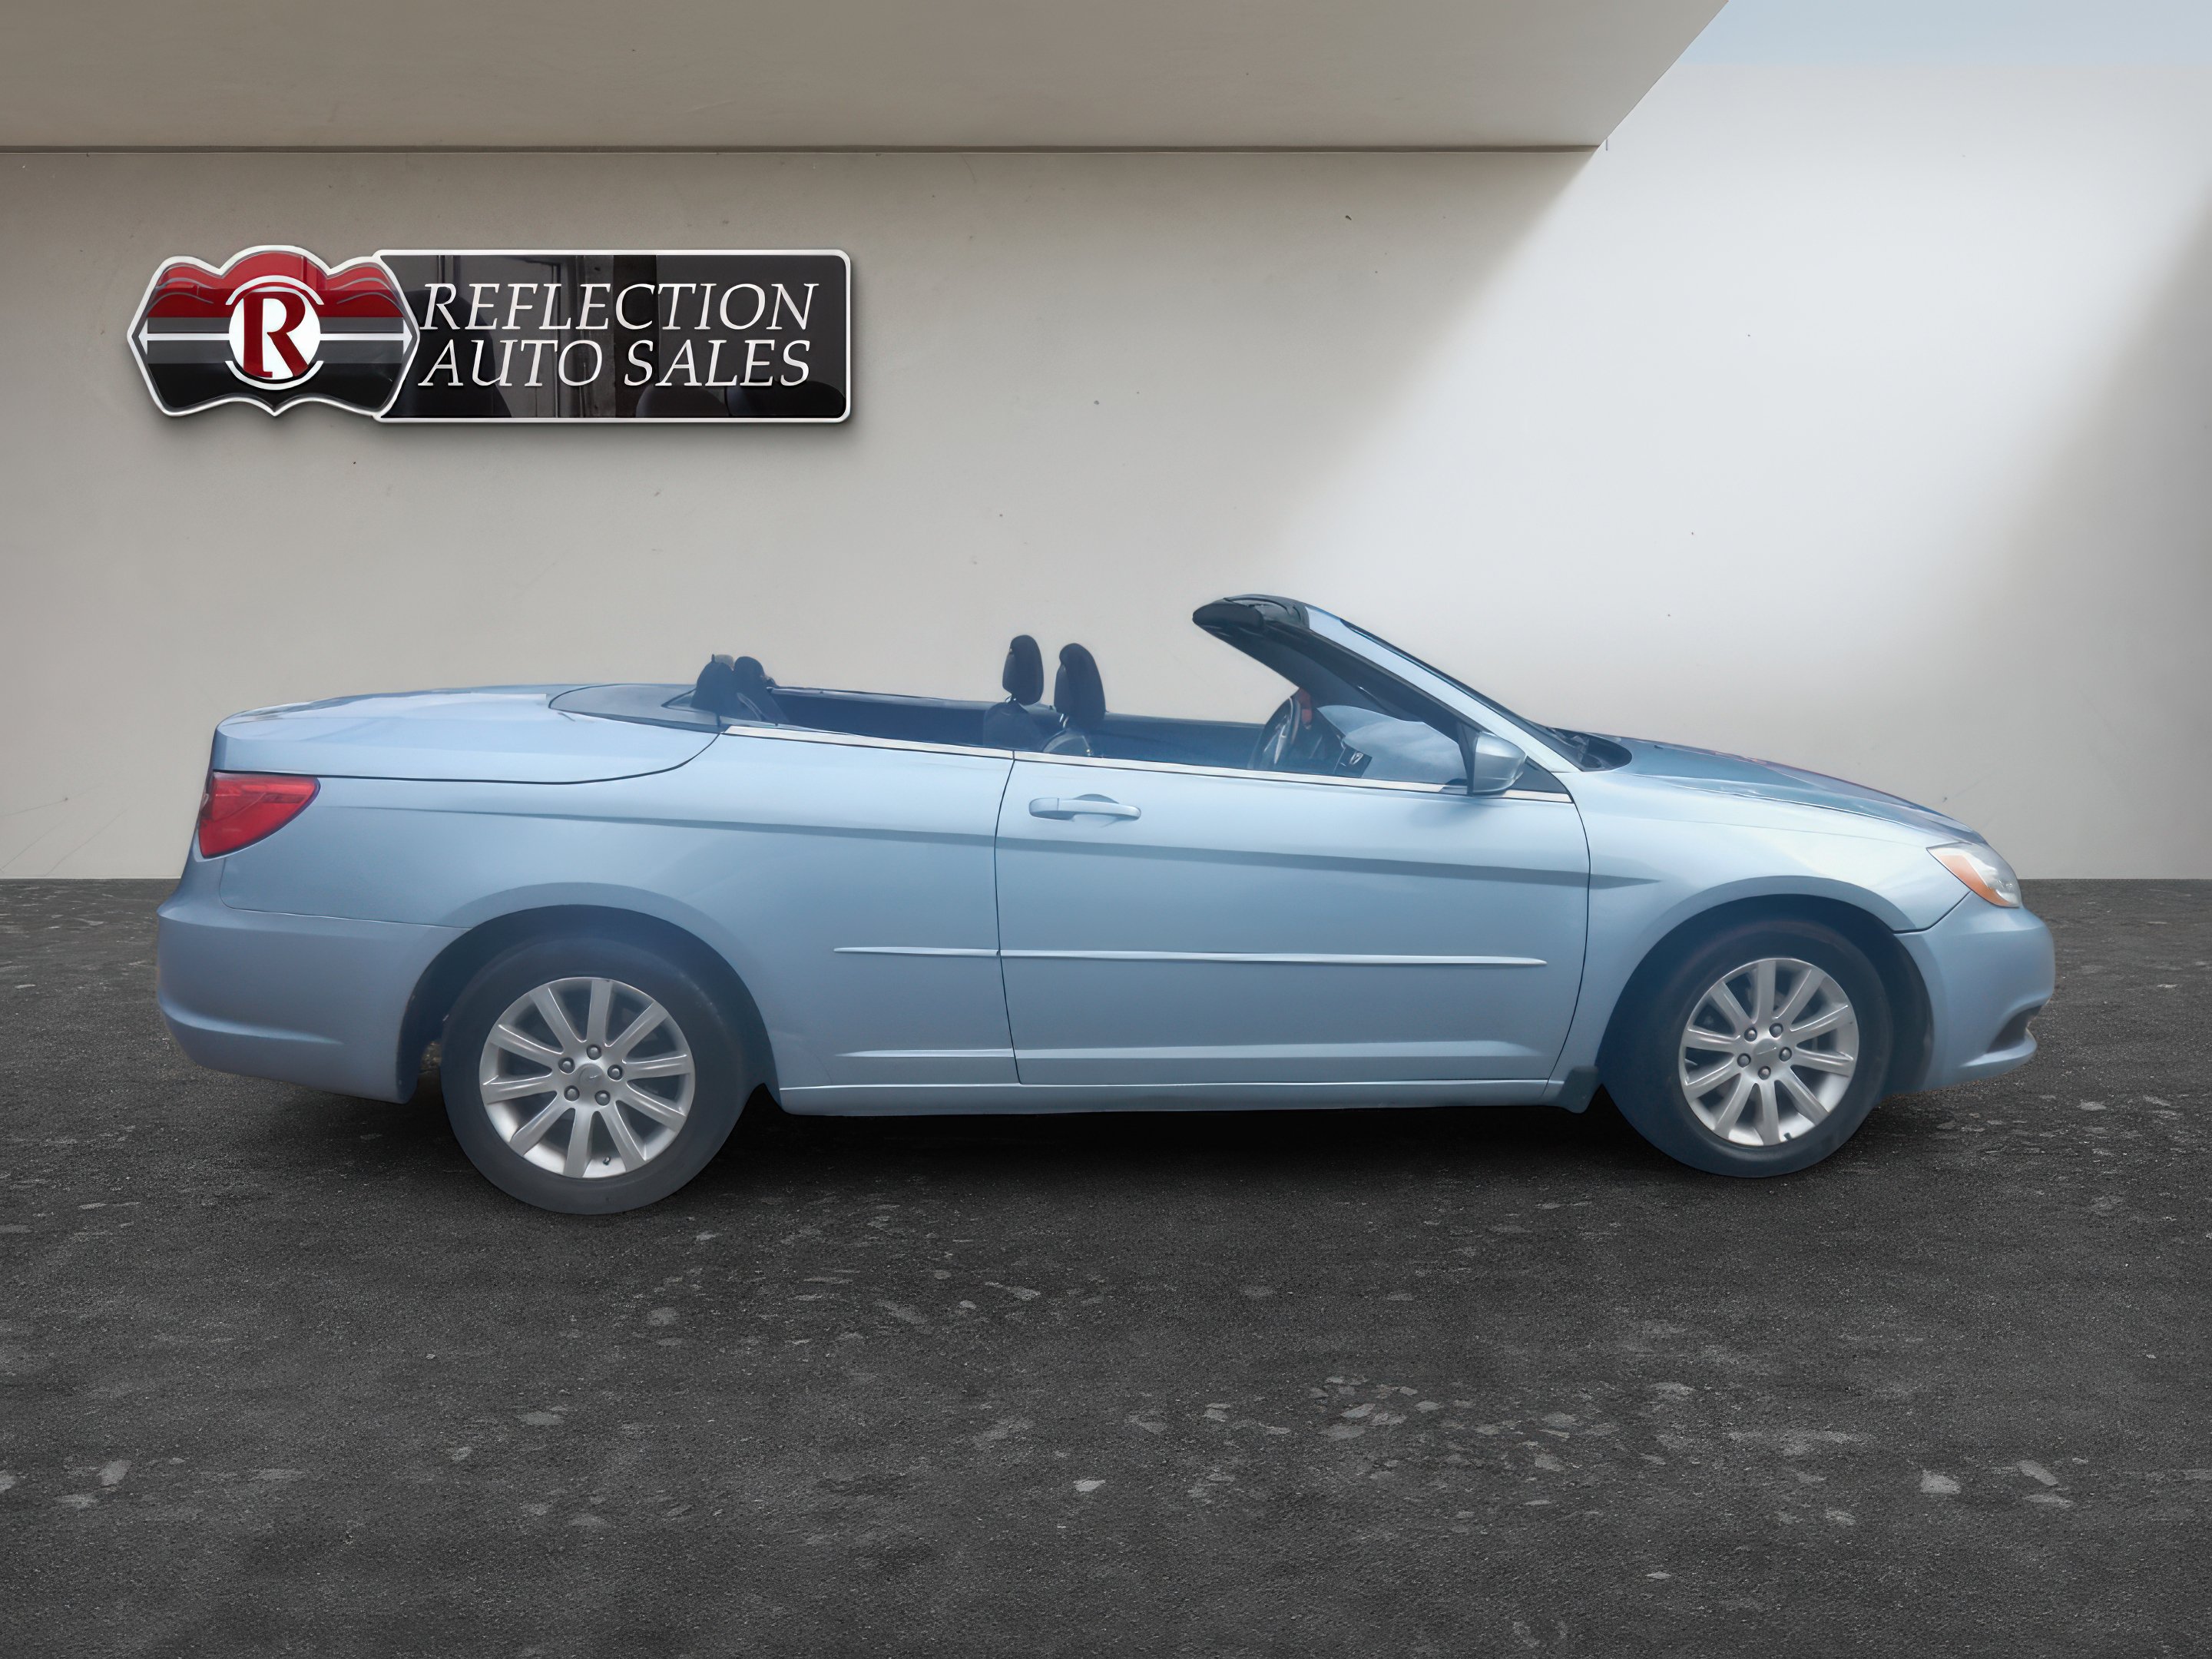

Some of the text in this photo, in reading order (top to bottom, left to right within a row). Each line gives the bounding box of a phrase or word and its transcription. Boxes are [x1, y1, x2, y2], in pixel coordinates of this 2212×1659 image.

[420, 283, 819, 330] REFLECTION
[243, 290, 310, 379] R
[418, 339, 811, 386] AUTO SALES
